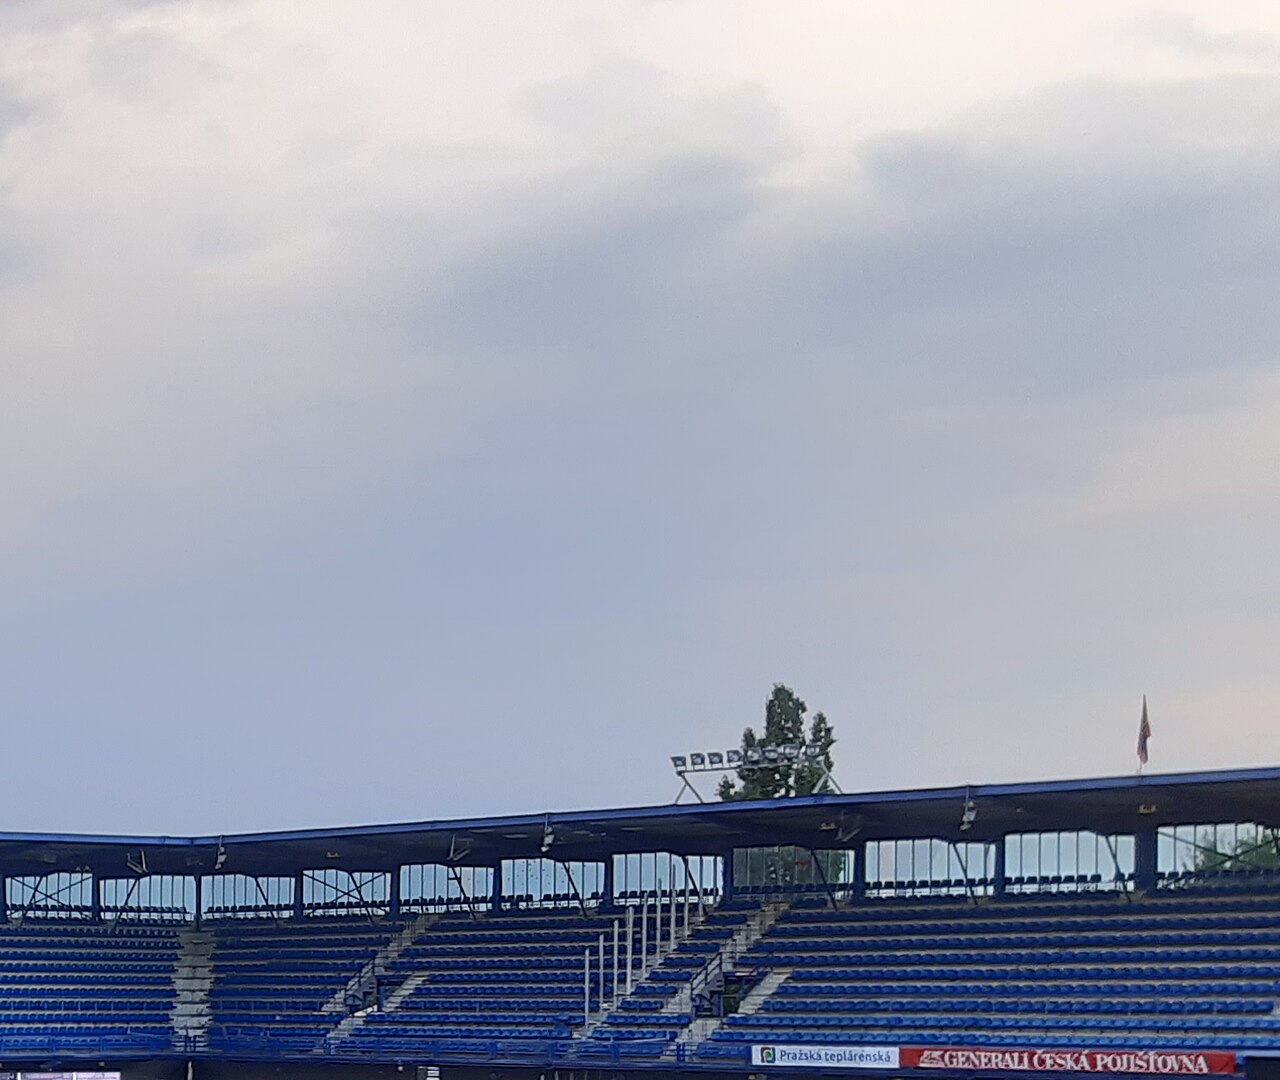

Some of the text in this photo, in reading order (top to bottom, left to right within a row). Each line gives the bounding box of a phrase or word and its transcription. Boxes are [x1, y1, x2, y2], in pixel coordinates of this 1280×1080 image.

[780, 1049, 891, 1064] Pražská teplárenská
[943, 1050, 1210, 1074] GENERALI ČESKÁ POJIŠŤOVNA
